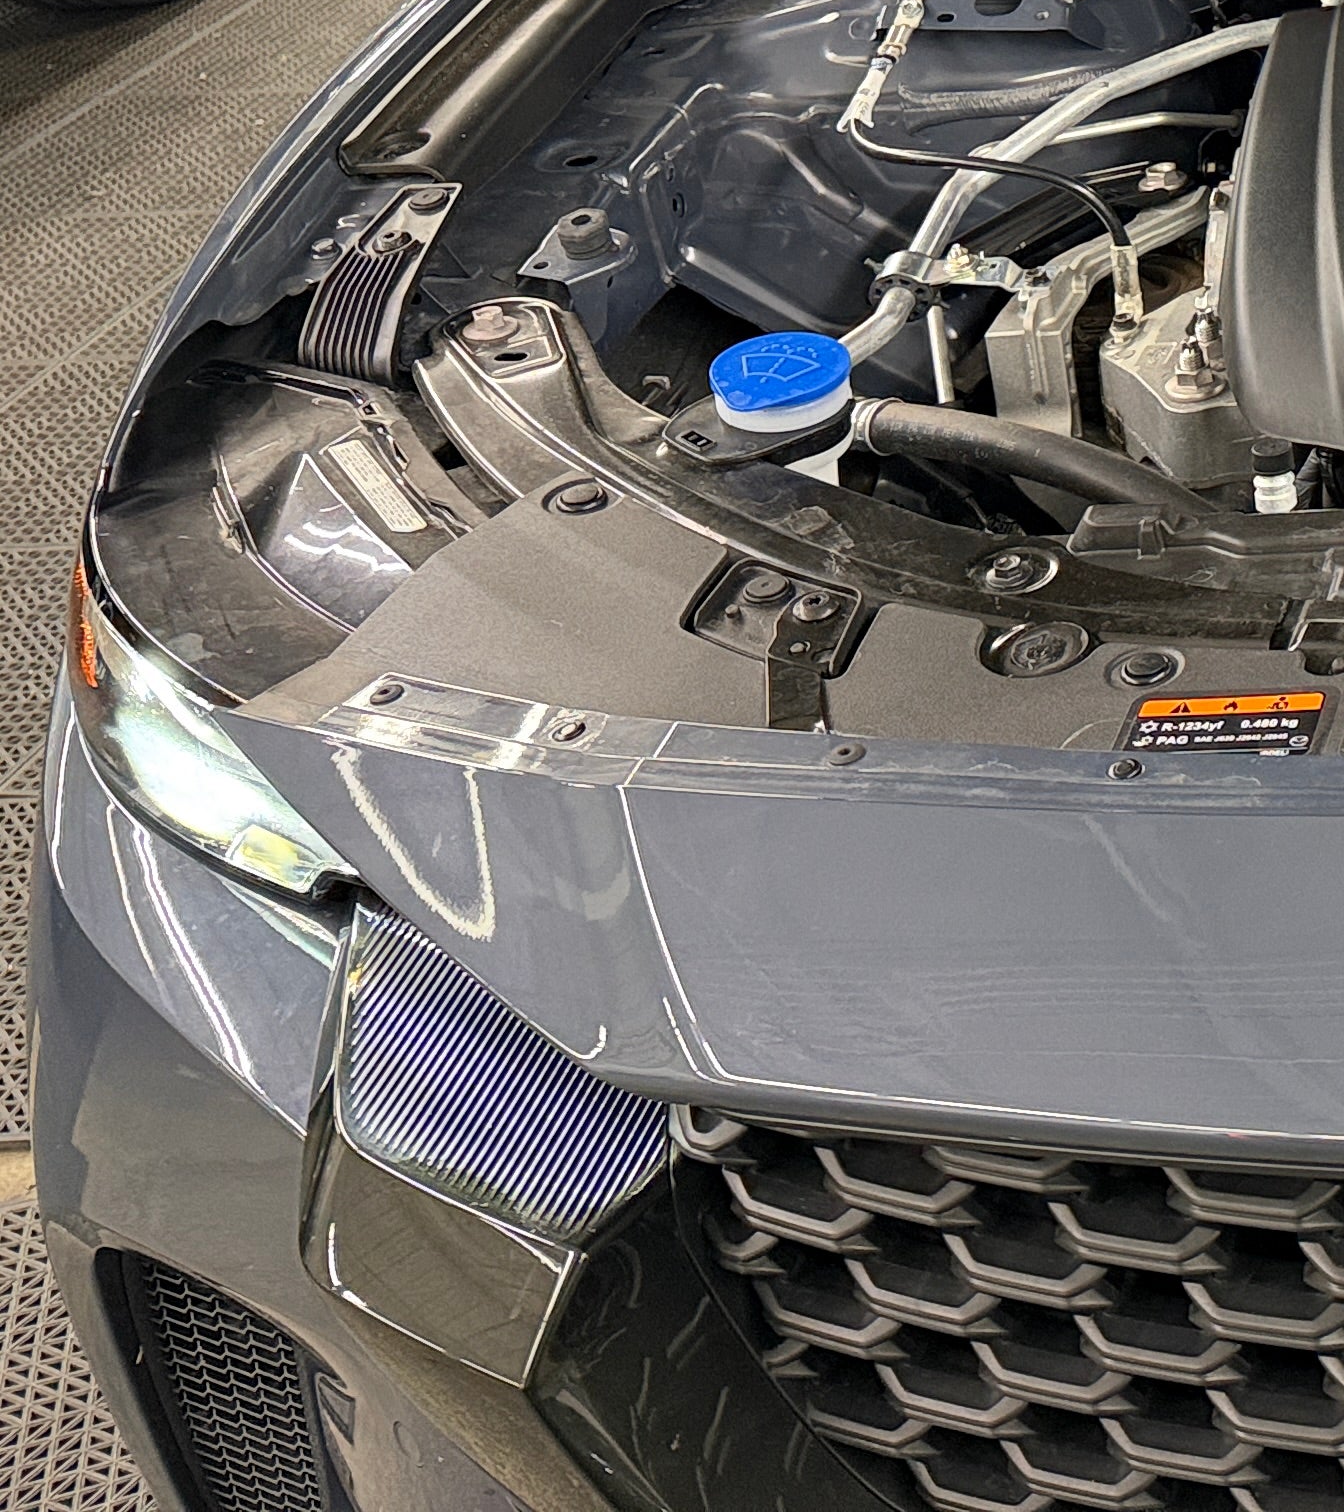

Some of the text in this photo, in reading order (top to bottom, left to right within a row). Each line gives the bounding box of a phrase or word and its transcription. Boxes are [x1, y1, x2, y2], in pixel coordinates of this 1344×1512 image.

[1160, 720, 1225, 732] R-1234yf
[1280, 717, 1299, 729] kg
[1155, 735, 1189, 745] PAG
